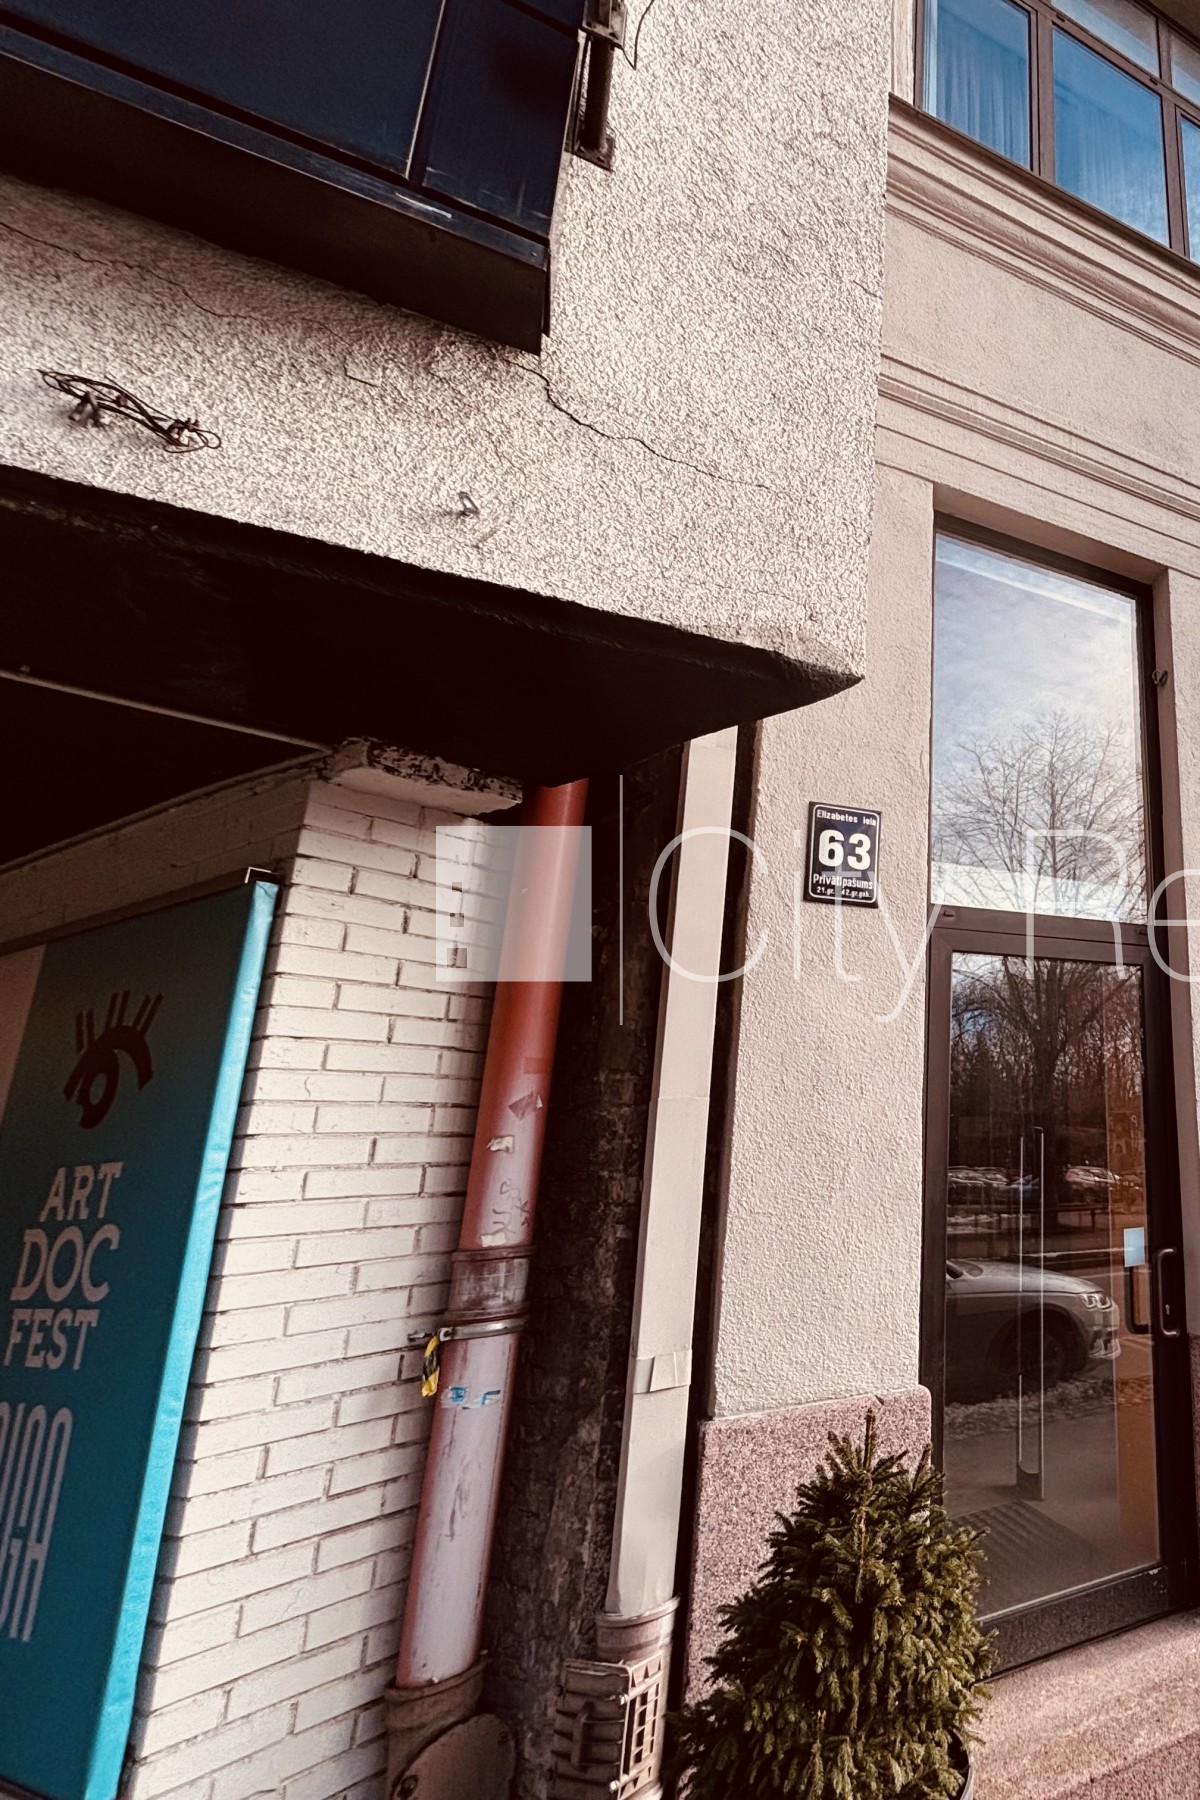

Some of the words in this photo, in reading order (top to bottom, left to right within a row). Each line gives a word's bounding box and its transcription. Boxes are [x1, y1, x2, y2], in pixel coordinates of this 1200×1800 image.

[816, 809, 858, 823] Elizabetes
[862, 816, 877, 826] iela
[818, 829, 871, 870] 63
[39, 1161, 124, 1222] ART
[10, 1223, 120, 1303] DOC
[3, 1307, 100, 1371] FEST
[0, 1401, 73, 1643] IGA
